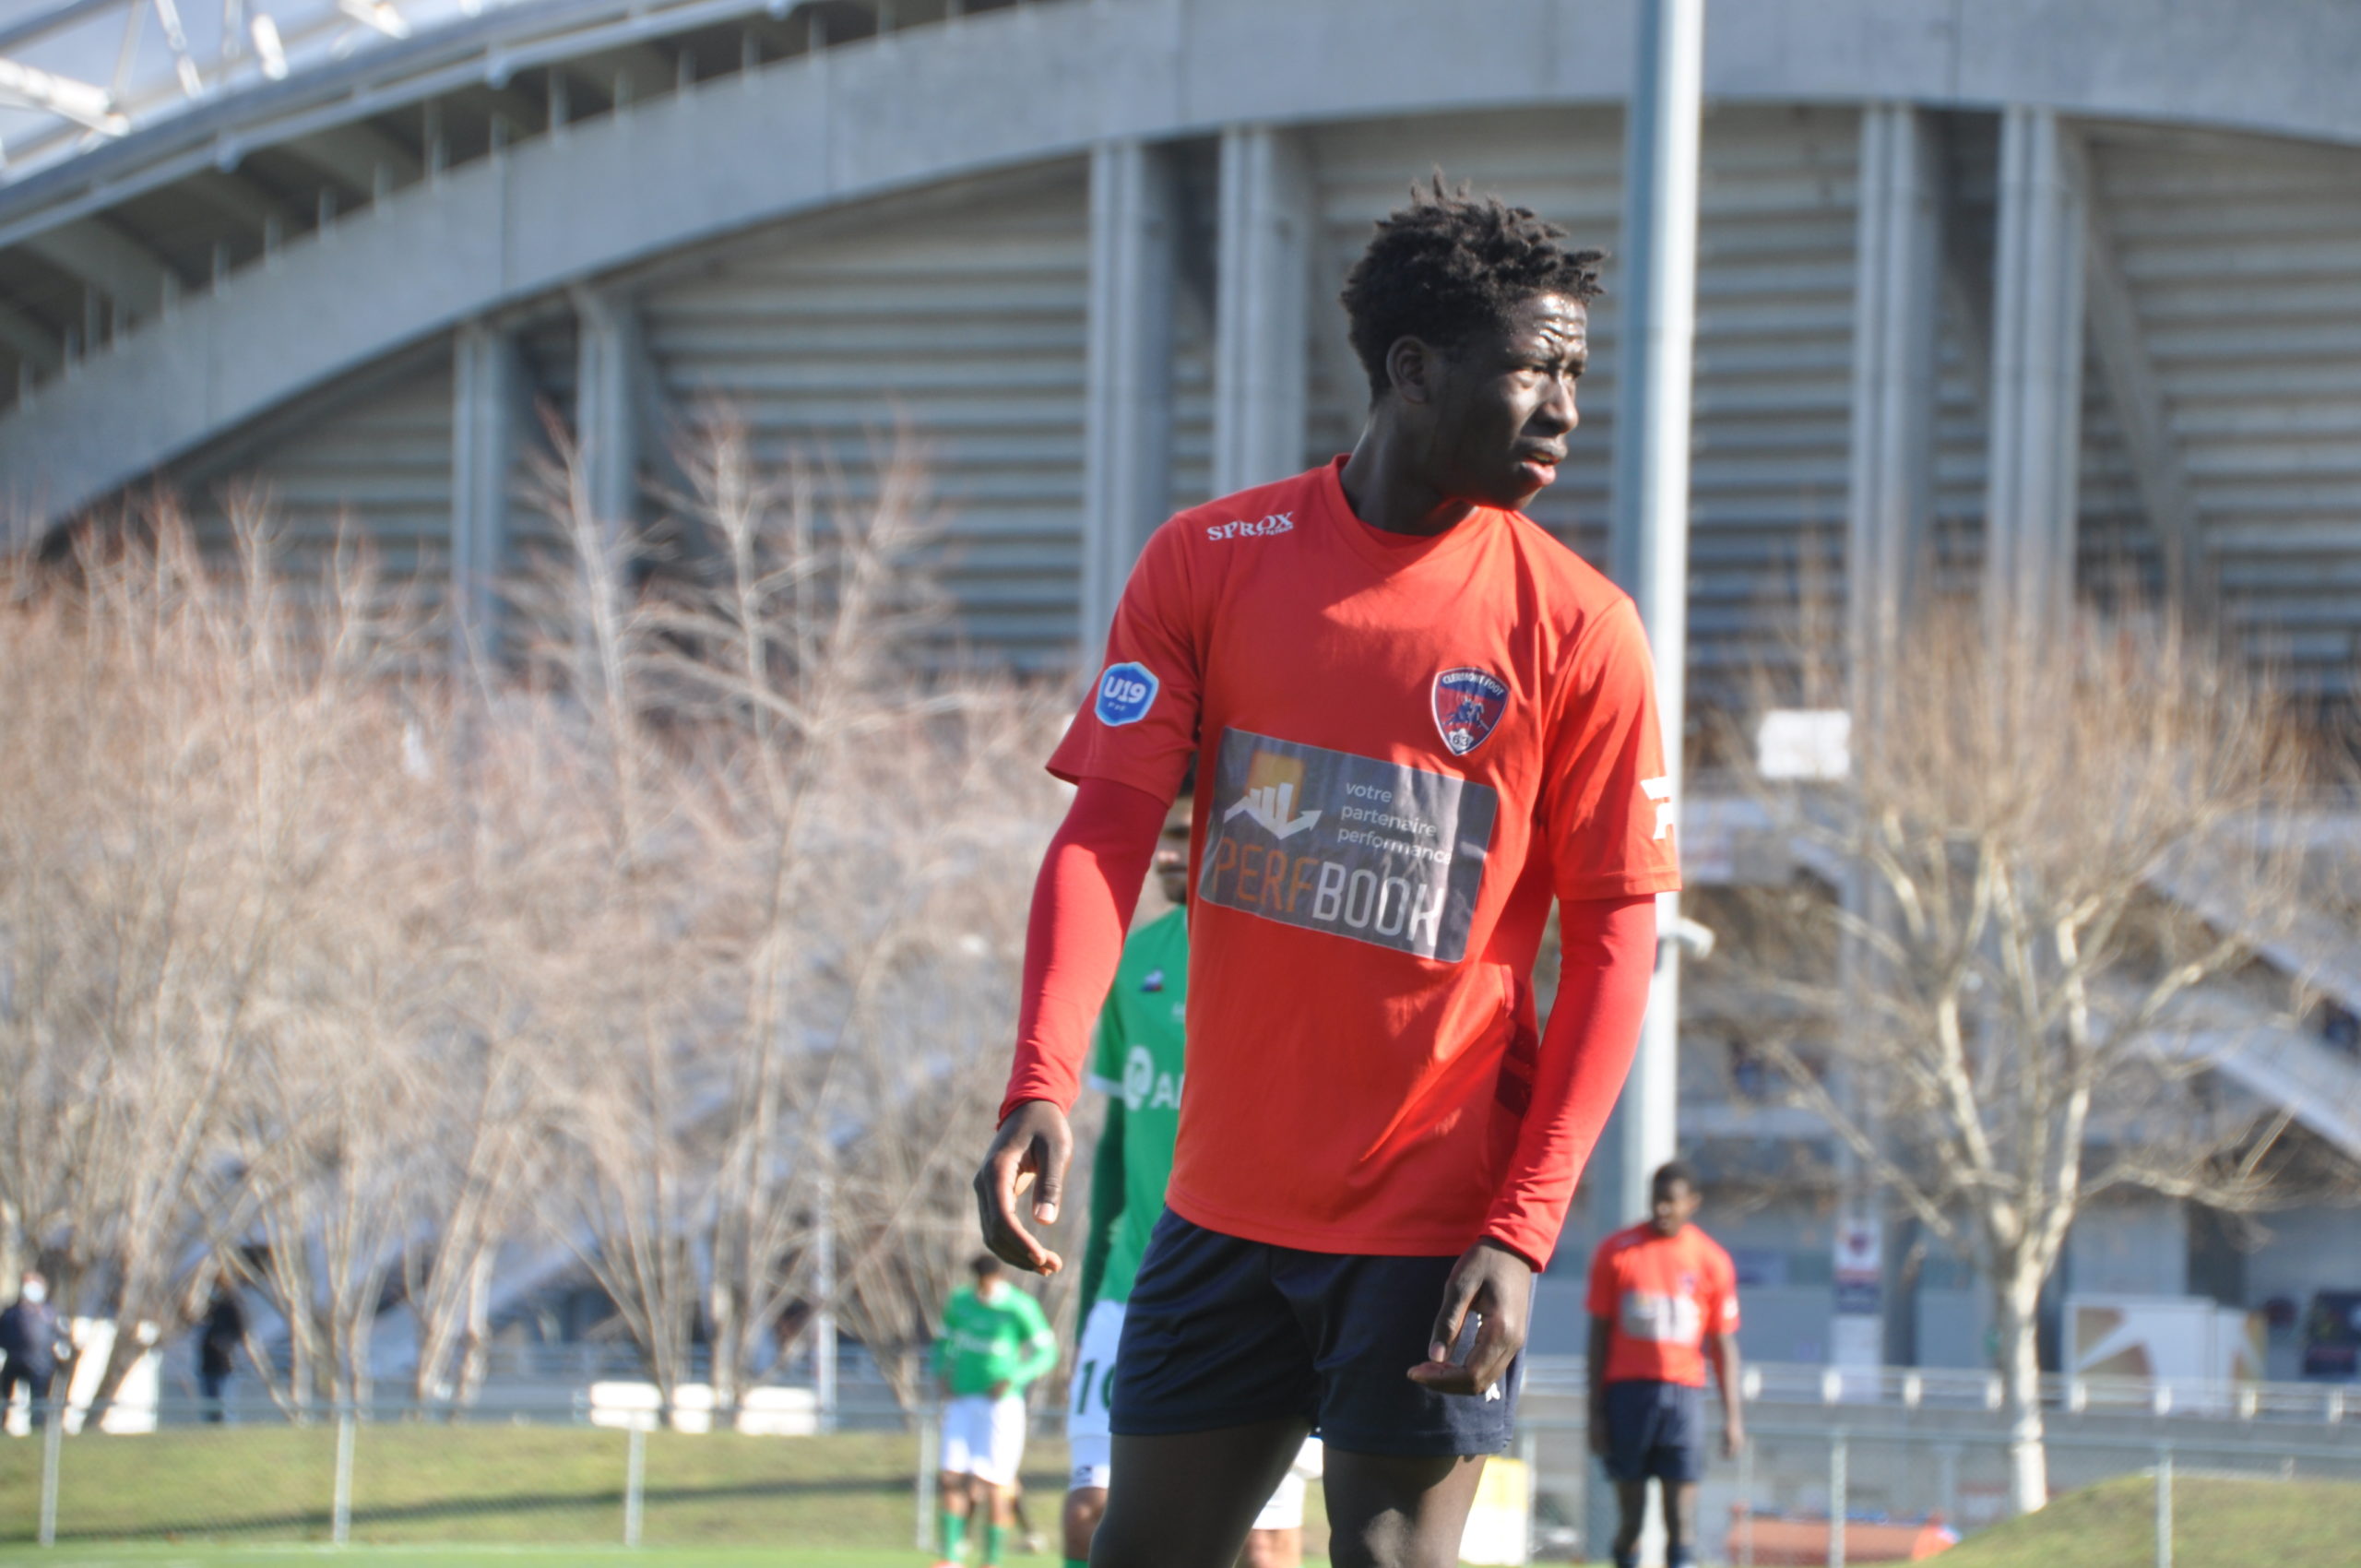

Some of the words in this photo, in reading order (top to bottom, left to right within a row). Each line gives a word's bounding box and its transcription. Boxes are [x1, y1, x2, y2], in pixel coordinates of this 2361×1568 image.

[1104, 675, 1146, 704] U19
[1453, 734, 1469, 747] 63
[1346, 782, 1392, 802] votre
[1341, 805, 1437, 837] partenaire
